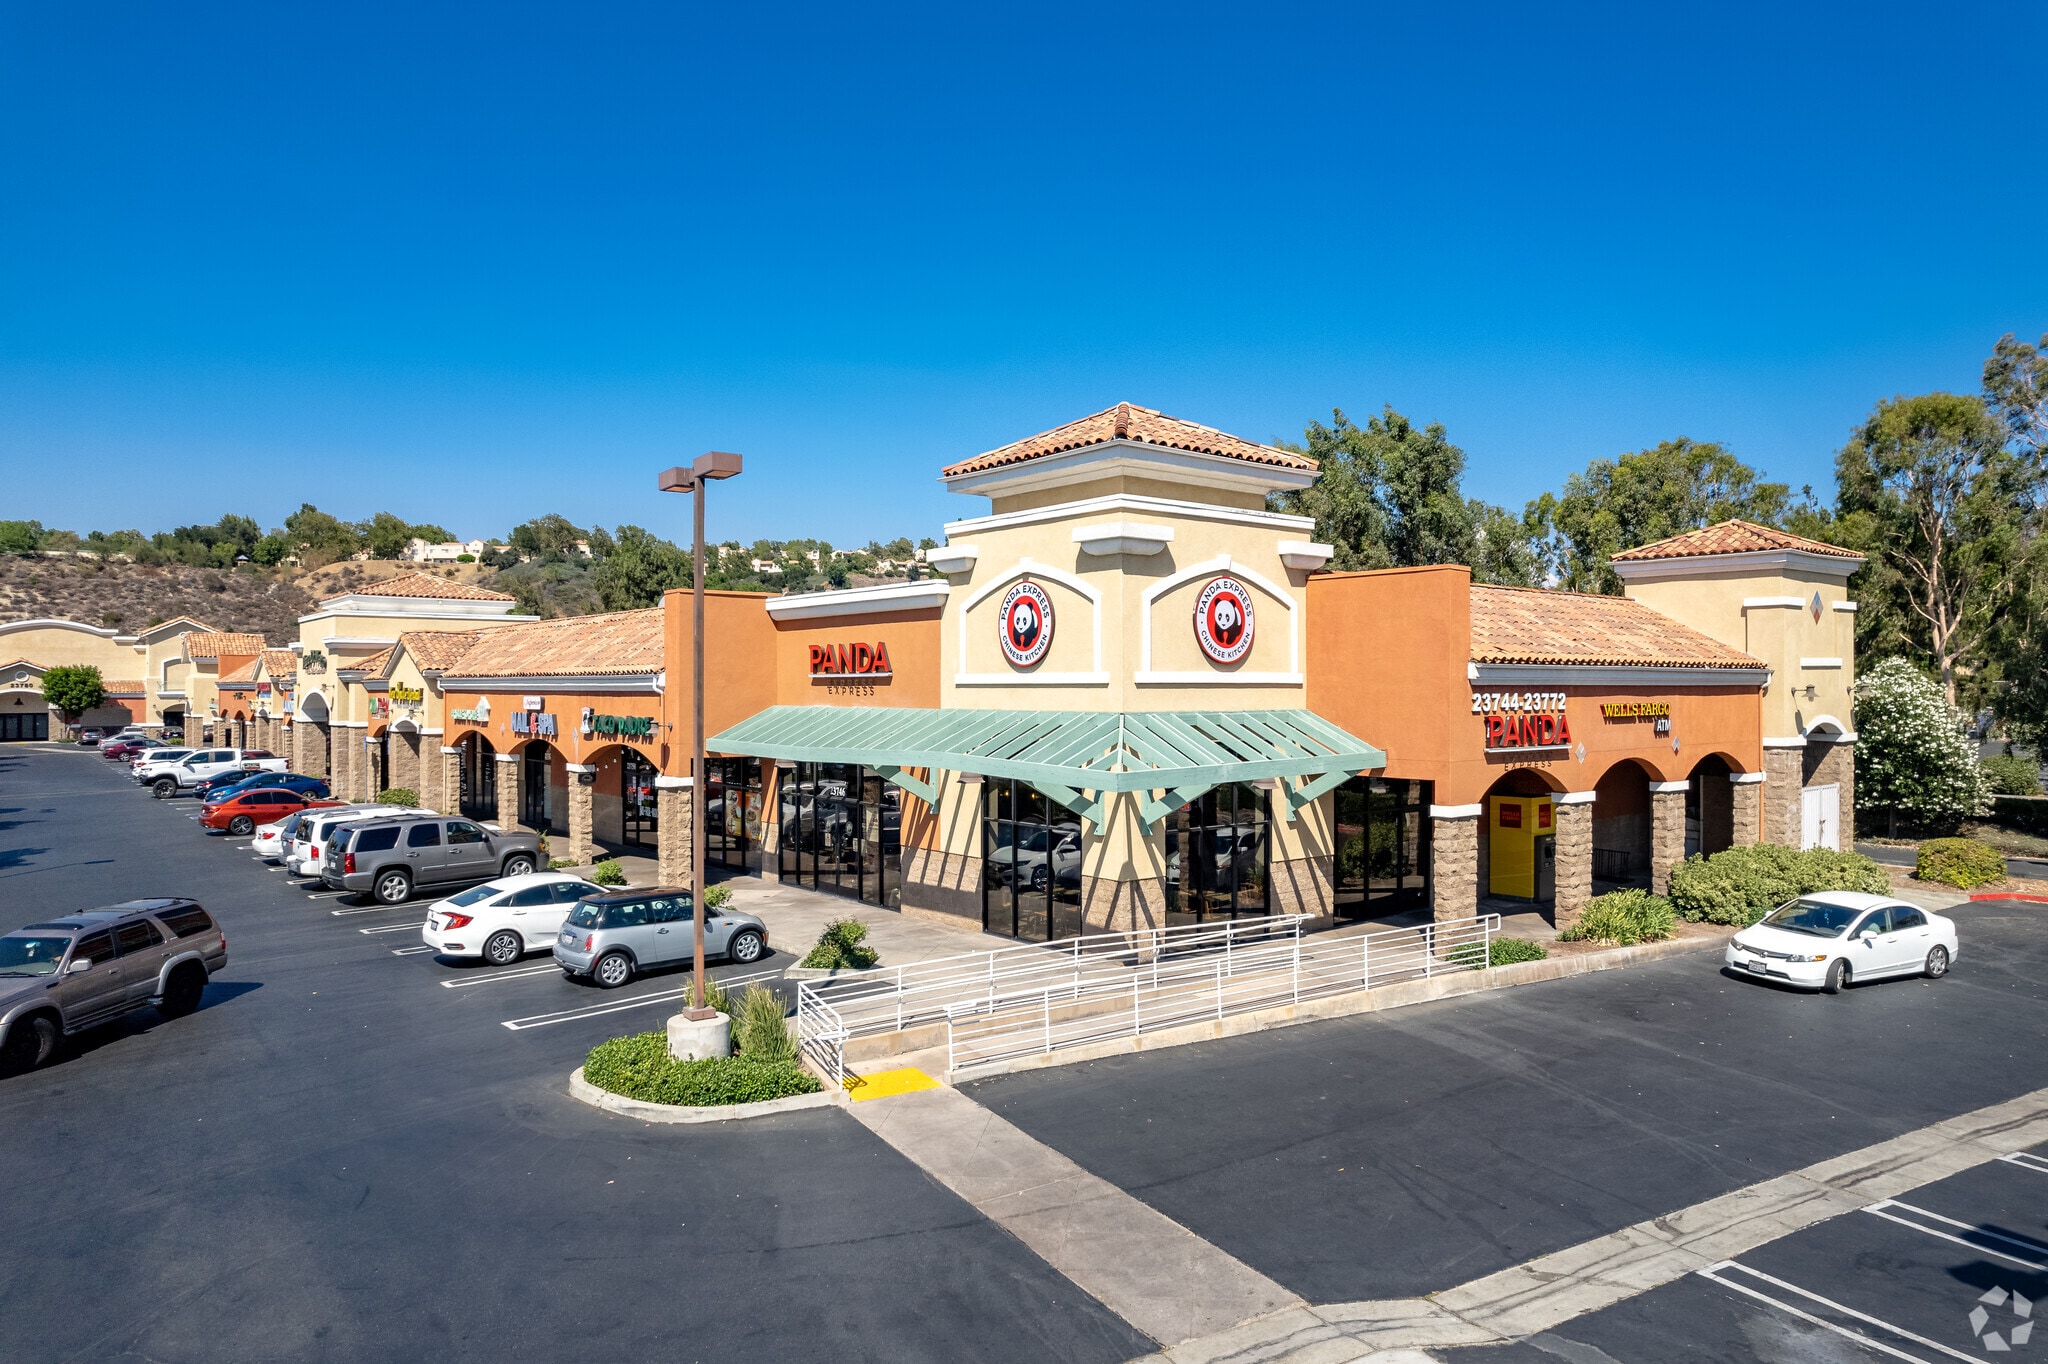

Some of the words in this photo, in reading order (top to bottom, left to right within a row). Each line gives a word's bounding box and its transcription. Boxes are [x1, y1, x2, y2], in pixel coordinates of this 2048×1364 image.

[1001, 589, 1021, 621] PANDA
[1022, 585, 1050, 620] EXPRESS
[1199, 583, 1222, 615] PANDA
[1223, 580, 1252, 618] EXPRESS
[808, 641, 892, 673] PANDA
[1002, 634, 1023, 662] CHINESE
[1024, 633, 1048, 662] KITCHEN
[1201, 629, 1226, 659] CHINESE
[1227, 631, 1251, 659] KITCHEN
[827, 681, 875, 697] EXPRESS
[1472, 692, 1566, 712] 23744-23772
[1602, 702, 1639, 717] WELLS
[1640, 702, 1671, 716] FARGO
[511, 711, 530, 733] NAIL
[530, 712, 538, 733] &
[538, 713, 556, 735] SPA
[593, 714, 615, 734] TACO
[618, 716, 651, 737] PADRE
[1486, 715, 1572, 747] PANDA
[1656, 719, 1671, 732] ATM
